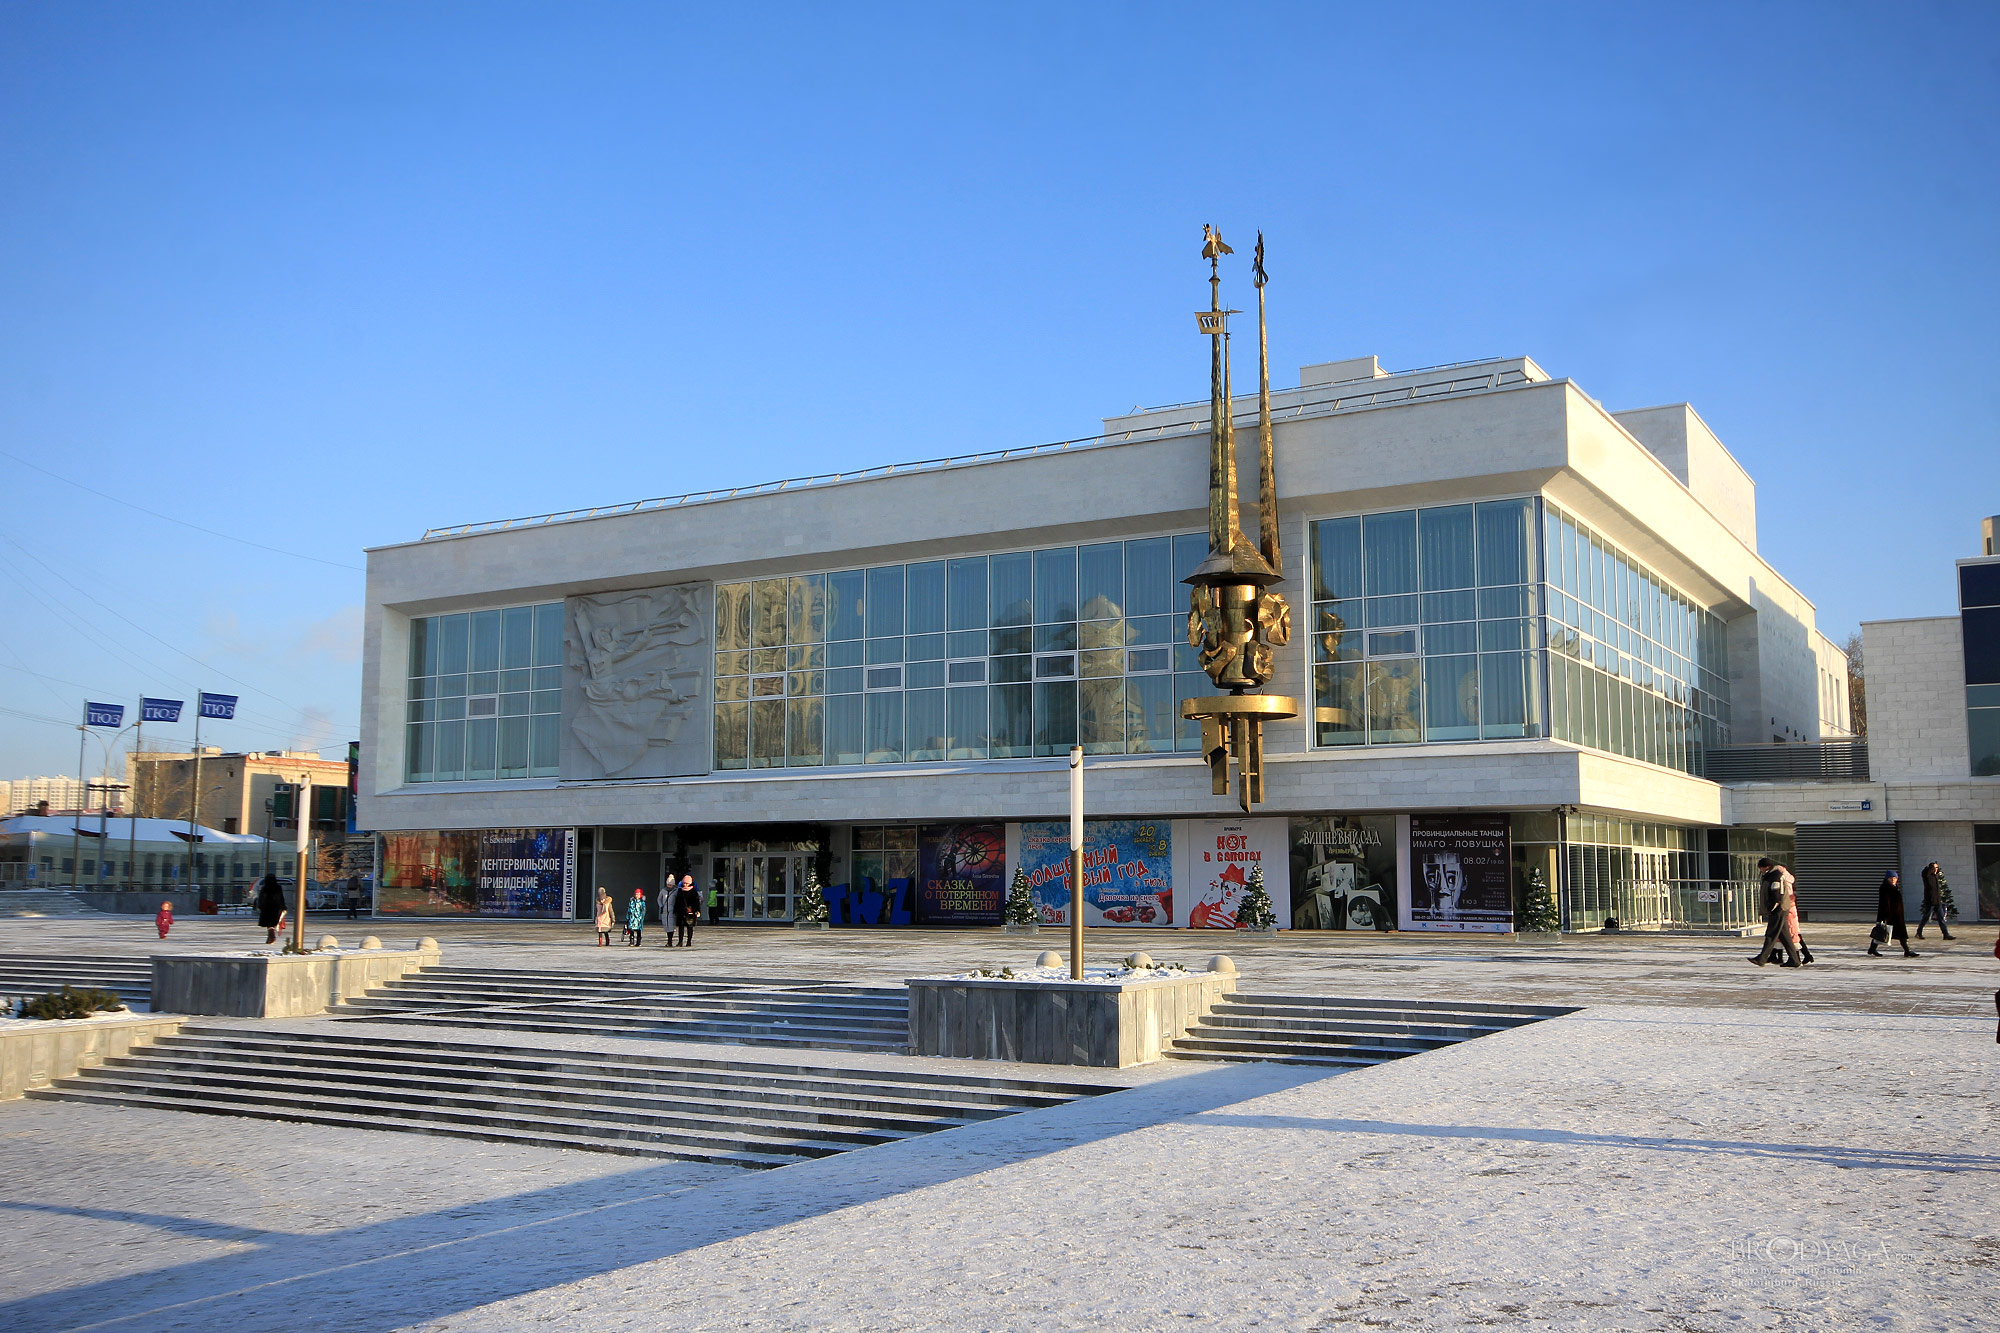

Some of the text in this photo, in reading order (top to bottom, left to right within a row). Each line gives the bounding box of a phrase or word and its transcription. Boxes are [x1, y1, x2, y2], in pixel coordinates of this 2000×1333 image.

[144, 707, 178, 719] ТЮЗ
[203, 703, 234, 716] ТЮЗ
[88, 712, 121, 725] ТЮЗ
[1139, 825, 1155, 837] 20
[1303, 827, 1382, 847] ВИШНЕВЫЙ САД
[1412, 830, 1504, 838] ПРОВИНЦИАЛЬНЫЕ ТАНЦЫ
[1158, 839, 1167, 851] 8
[1216, 834, 1248, 851] КОТ
[1412, 840, 1446, 848] ИМАГО
[1454, 840, 1505, 848] ЛОВУШКА
[481, 858, 560, 871] КЕНТЕРВИЛЬСКОЕ
[565, 836, 574, 913] БОЛЬШАЯ СЦЕНА
[1063, 860, 1150, 890] НВЫЙ ГОД
[481, 876, 539, 890] ПРИВИДЕНИЕ
[927, 879, 974, 890] СКАЗКА
[924, 890, 999, 900] О ПОТЕРЯННОМ
[940, 900, 997, 911] ВРЕМЕНИ
